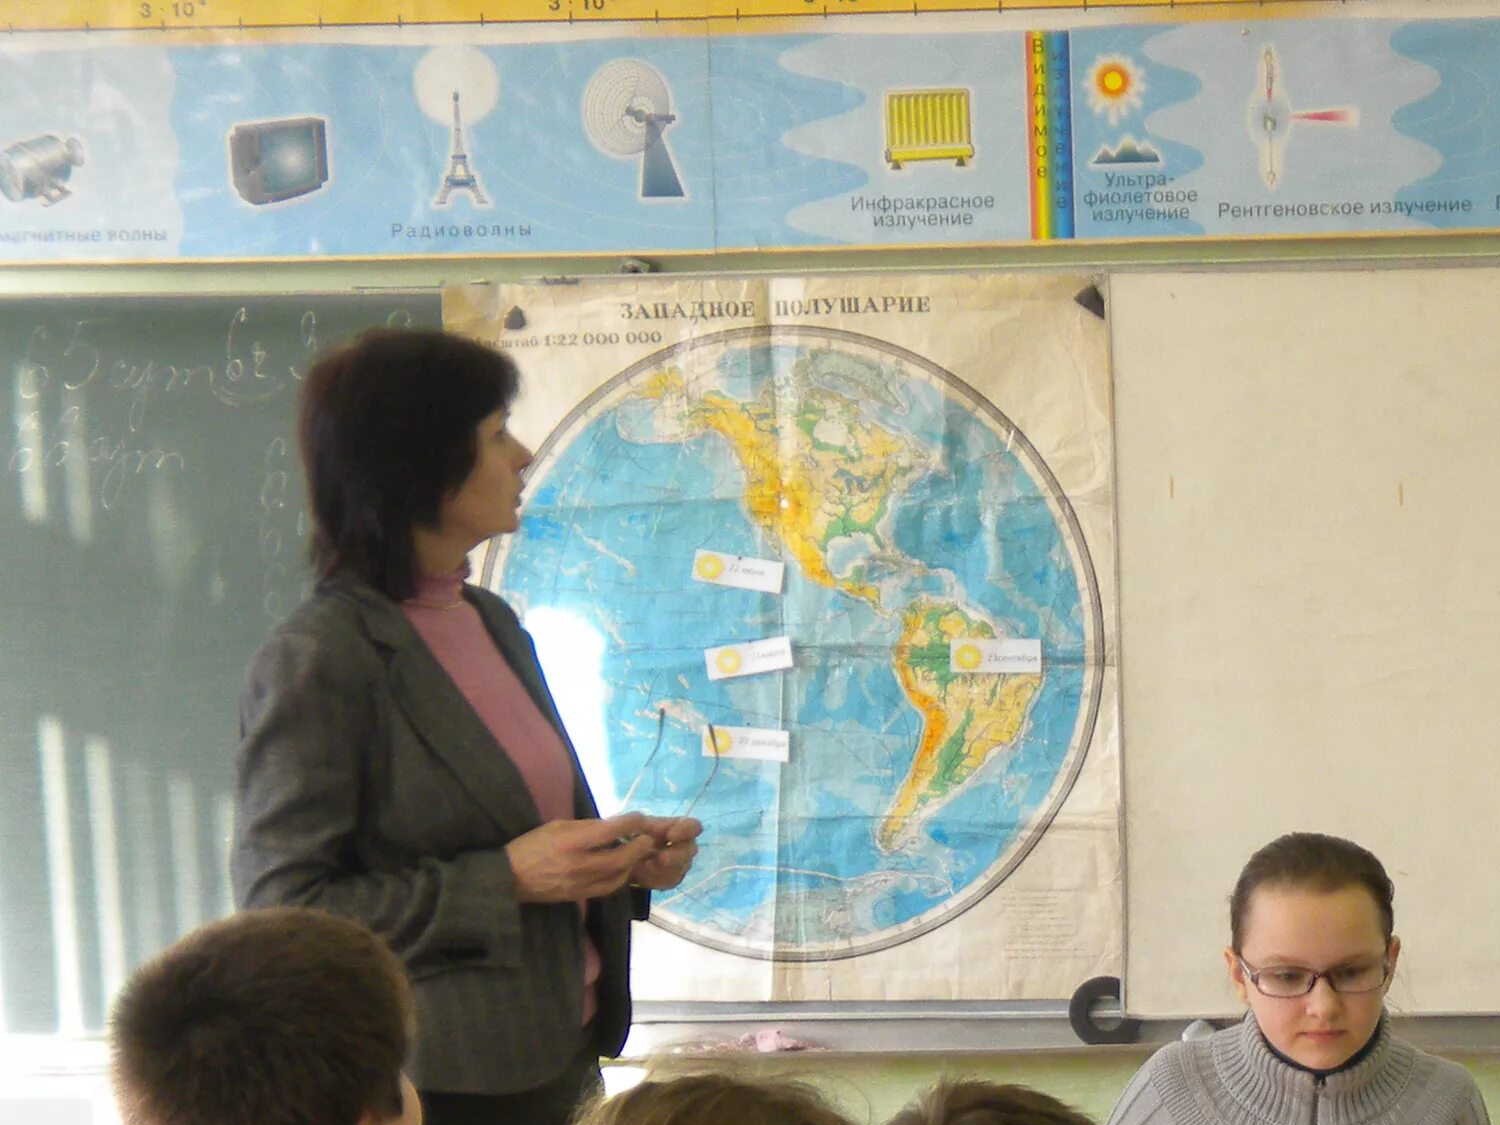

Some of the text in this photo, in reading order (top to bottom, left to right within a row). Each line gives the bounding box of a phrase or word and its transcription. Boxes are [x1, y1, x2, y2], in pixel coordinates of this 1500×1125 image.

[1032, 39, 1048, 178] Видимое
[1104, 173, 1175, 189] Ультра-
[851, 194, 995, 214] Инфракрасное
[1083, 188, 1198, 207] фиолетовое
[1092, 206, 1190, 223] излучение
[1218, 197, 1473, 219] Рентгеновское излучение
[873, 211, 973, 229] излучение
[391, 222, 533, 239] Радиоволны
[620, 295, 932, 321] ЗАПАДНОЕ ПОЛУШАРИЕ
